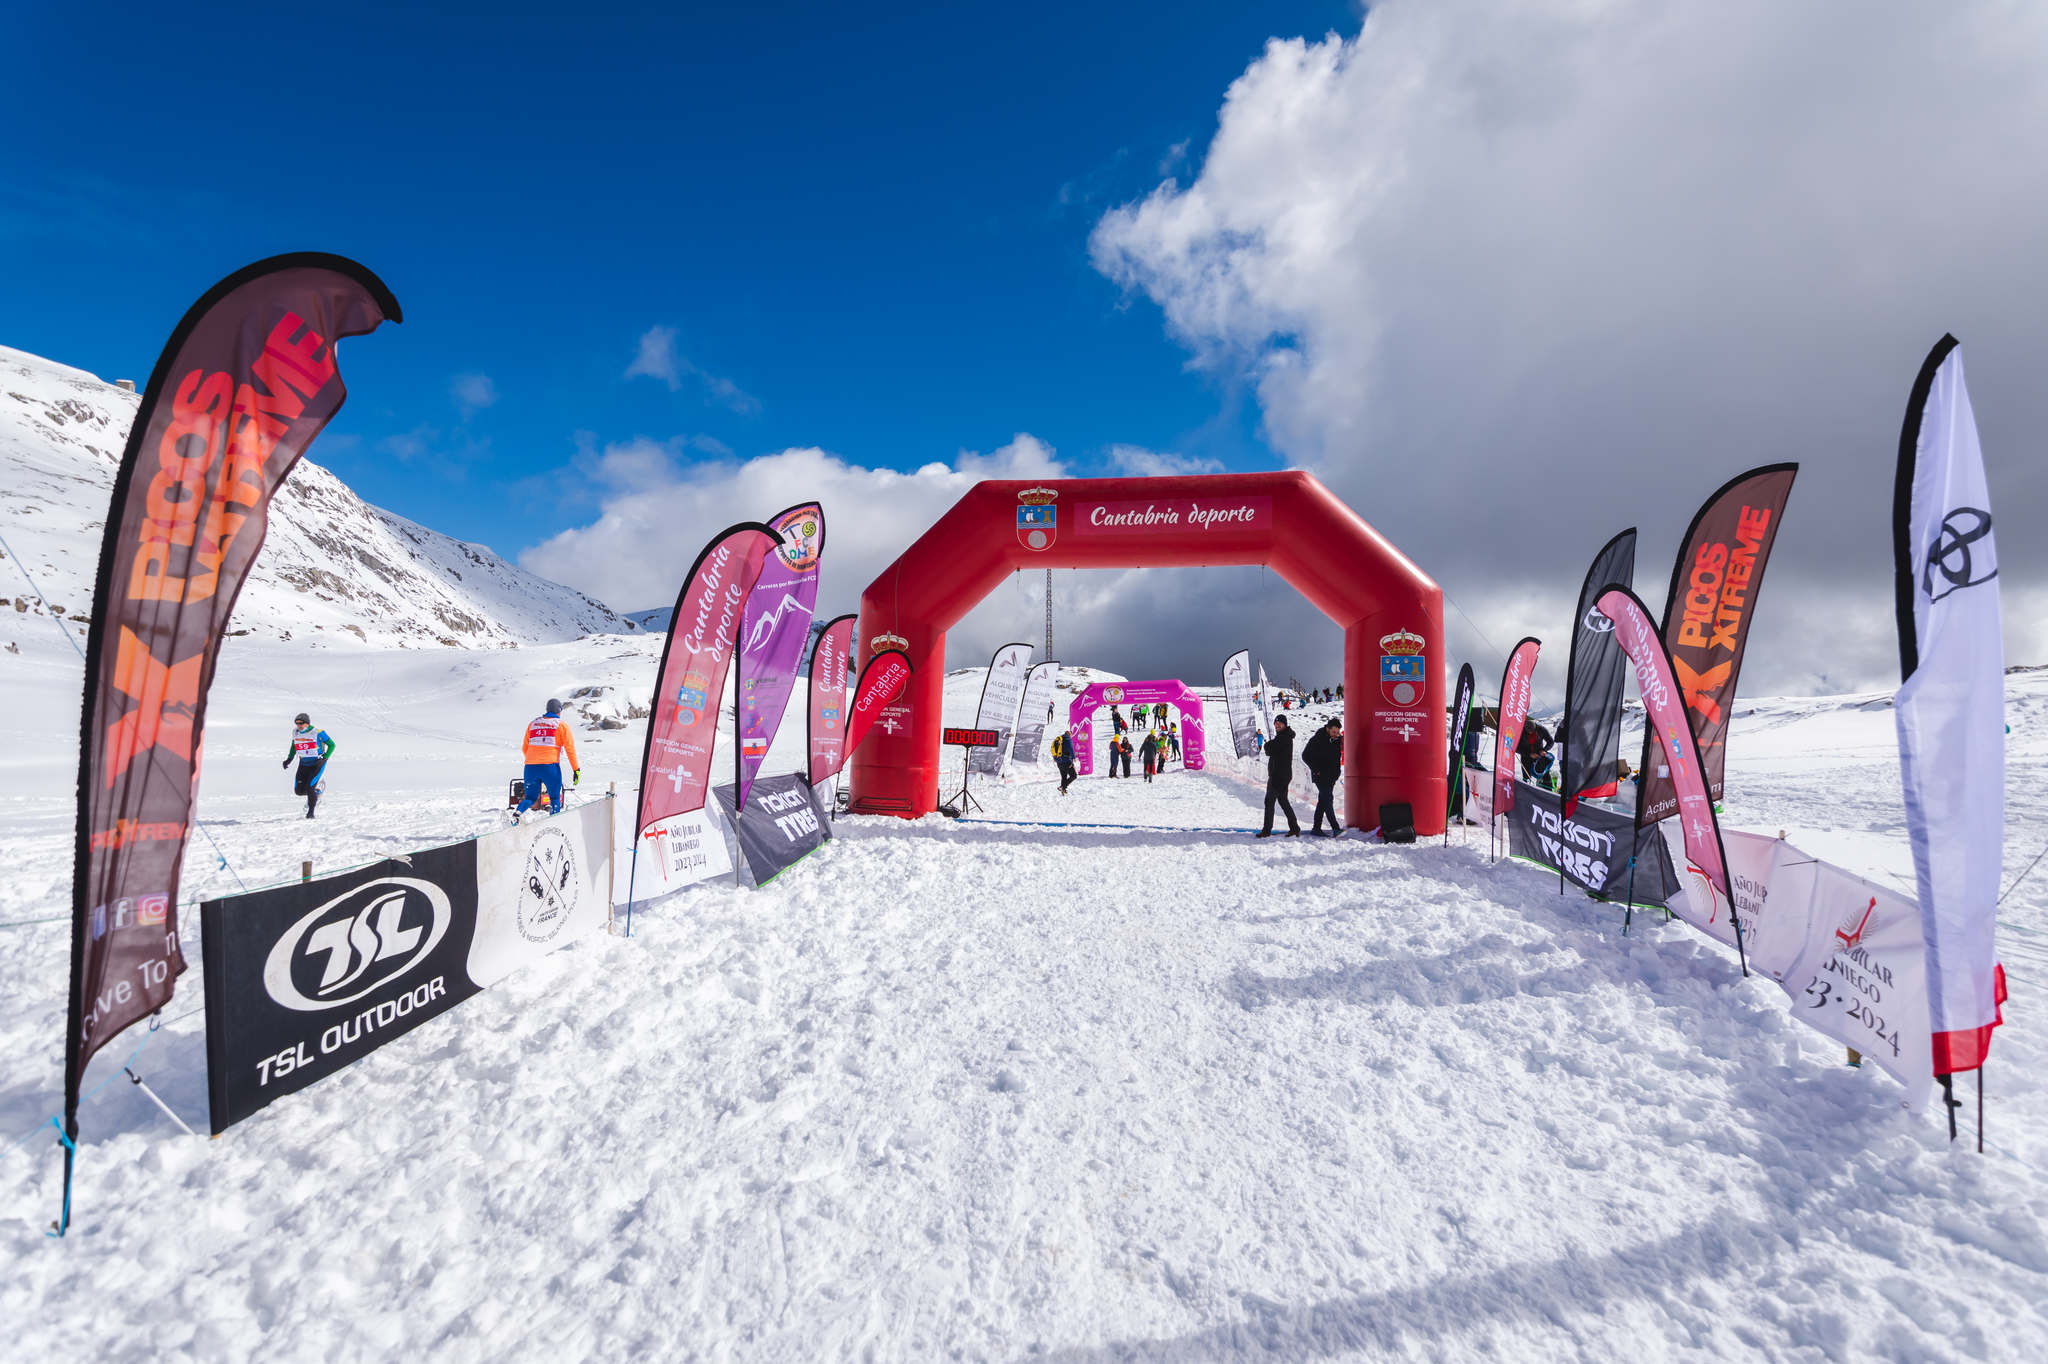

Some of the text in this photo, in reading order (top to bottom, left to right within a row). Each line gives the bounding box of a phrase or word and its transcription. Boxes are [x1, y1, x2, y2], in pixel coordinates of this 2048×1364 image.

[128, 369, 234, 600] PICOS
[1090, 503, 1255, 530] Cantabria deporte
[684, 546, 731, 655] Cantabria
[1677, 543, 1728, 648] PICOS
[1709, 505, 1772, 652] XTREME
[704, 583, 743, 662] deporte
[818, 633, 834, 693] Cantabria
[832, 651, 845, 693] deporte
[856, 663, 901, 712] Cantabria
[1506, 653, 1522, 718] Cantabria
[1514, 675, 1530, 723] deporte
[774, 807, 819, 842] TYRES
[1645, 798, 1677, 818] Active
[1537, 832, 1609, 891] TYRES
[1734, 875, 1753, 893] AÑO
[304, 889, 423, 996] TSL
[256, 975, 447, 1087] TSL OUTDOOR
[1846, 997, 1901, 1058] 2024
